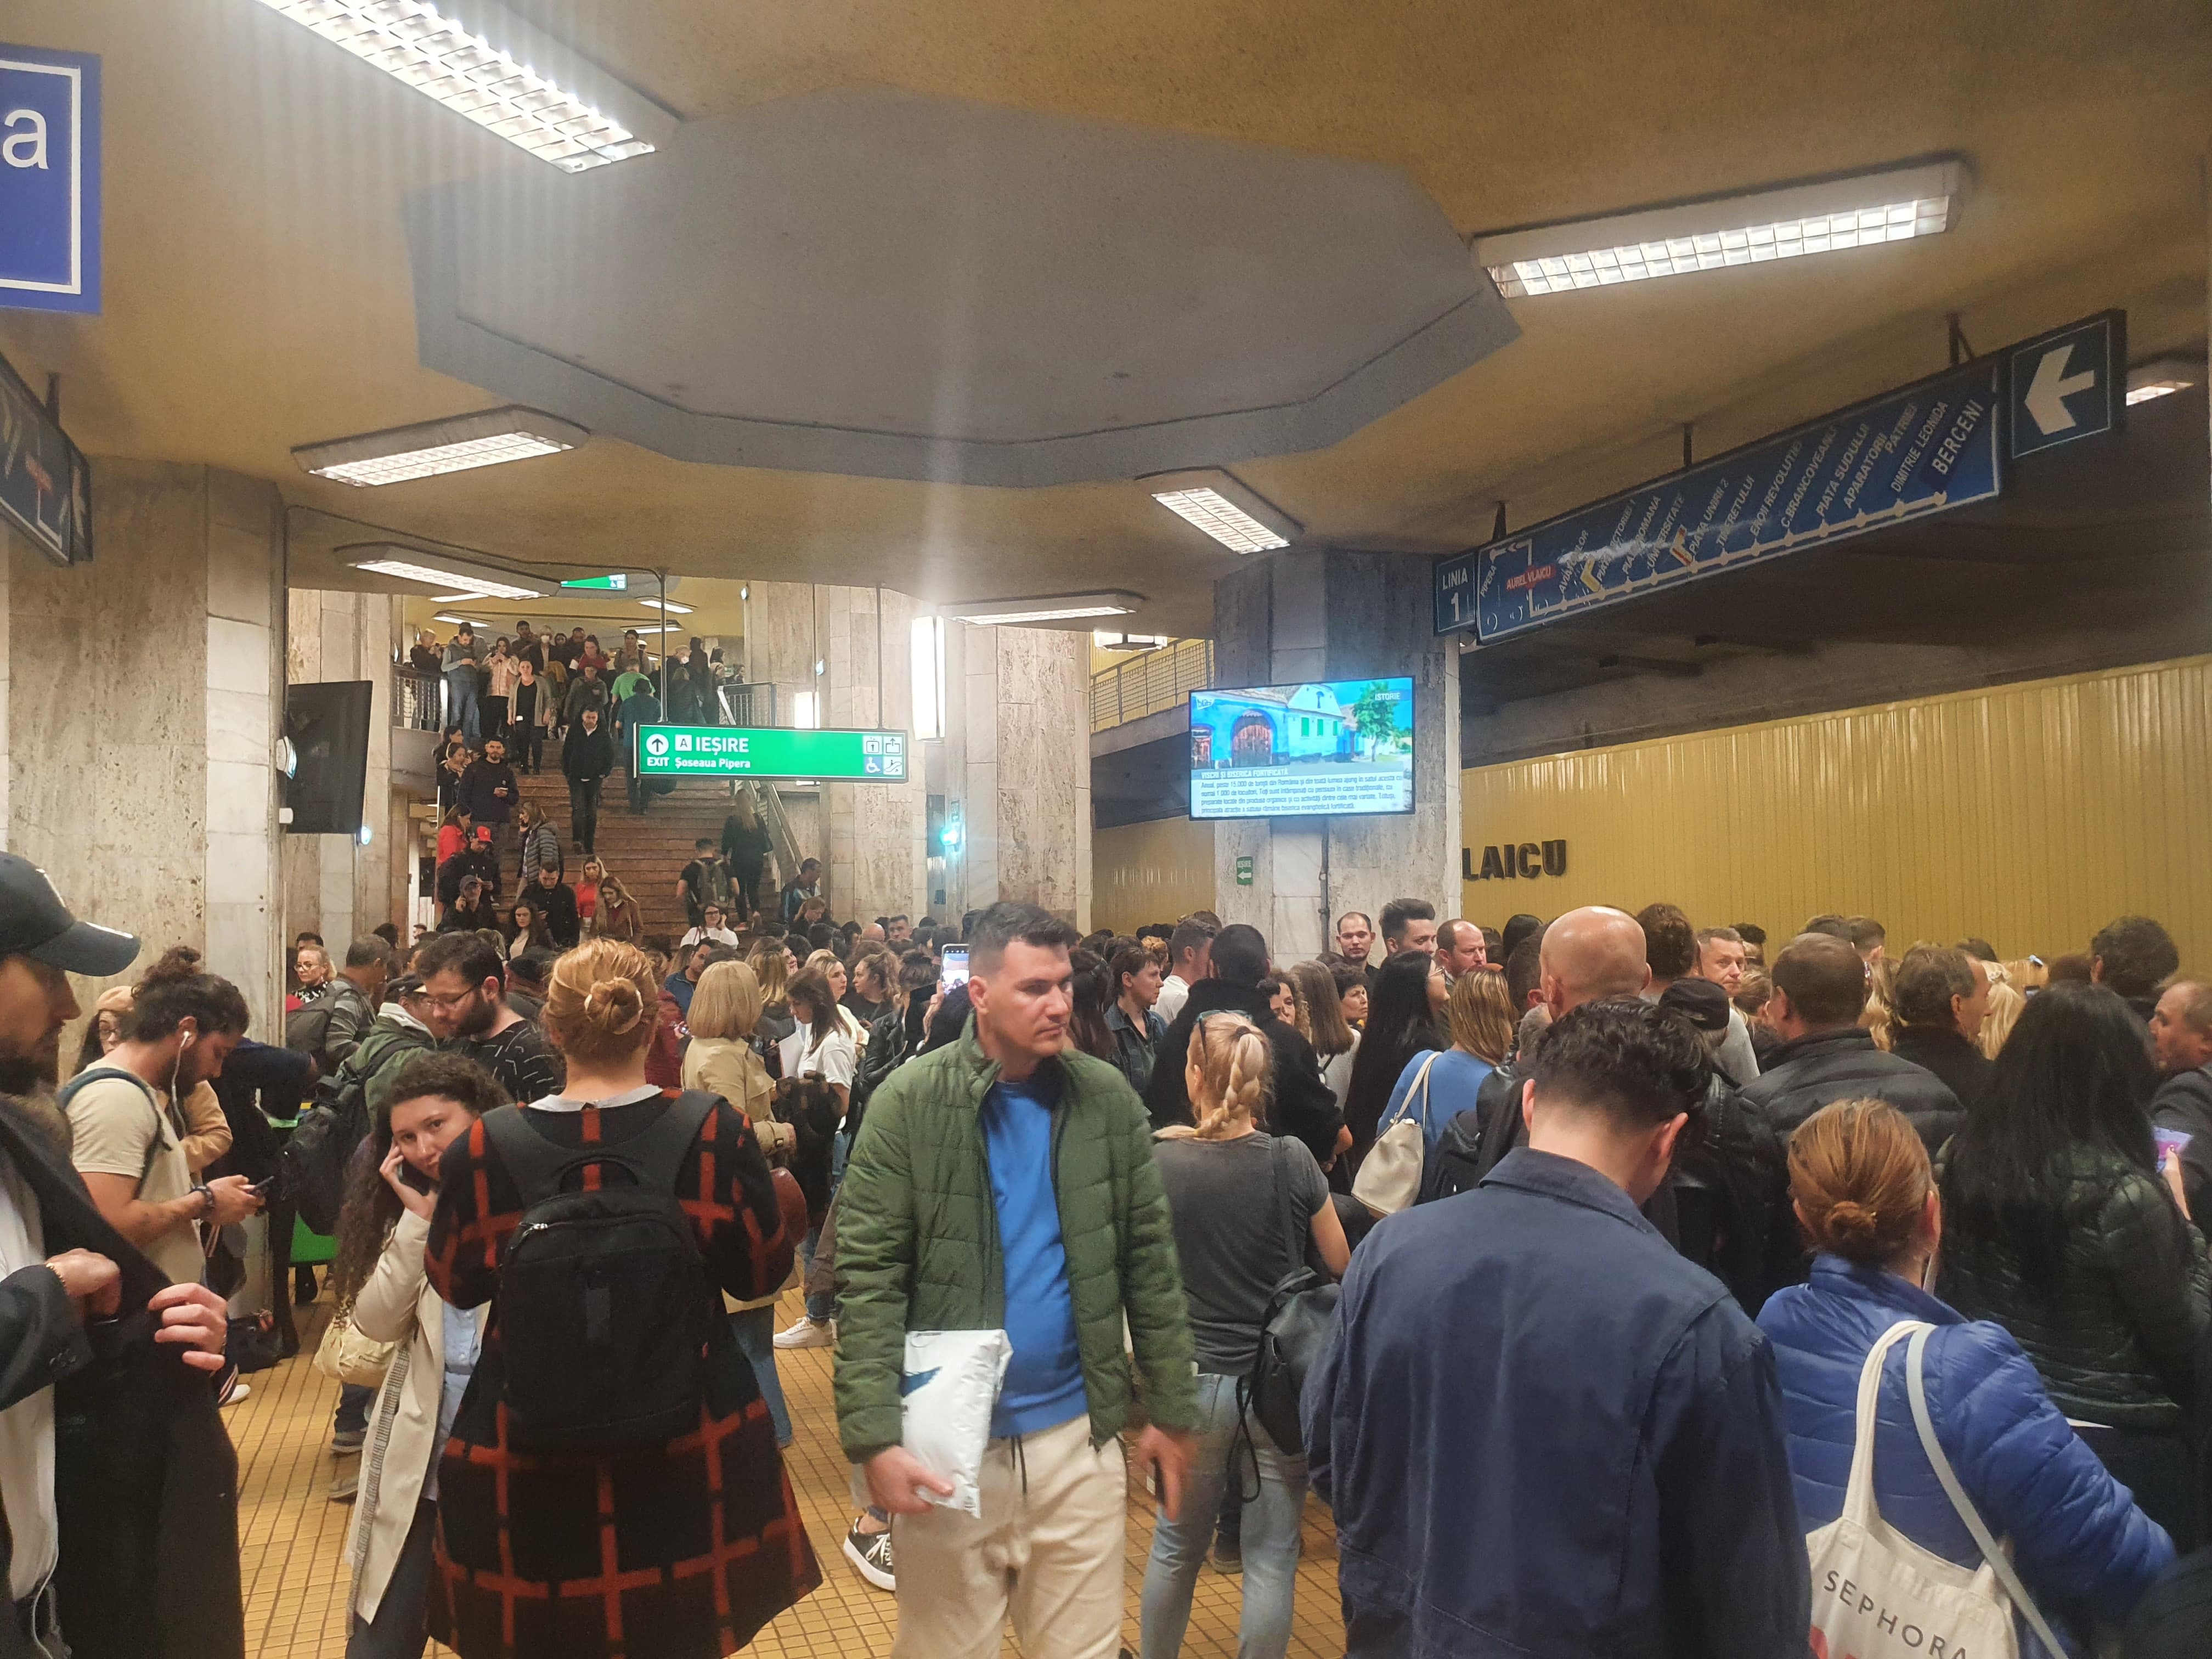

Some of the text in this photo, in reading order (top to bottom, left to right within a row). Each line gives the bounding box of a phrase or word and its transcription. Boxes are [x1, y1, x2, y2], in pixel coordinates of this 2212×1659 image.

[1891, 401, 1948, 493] DIMITRIE LEONIDA
[1932, 399, 1984, 475] BERCENI
[1647, 494, 1685, 568] UNIERSITATE
[1559, 529, 1589, 593] AVIATOLOR
[1442, 567, 1468, 591] LINIA
[1480, 565, 1497, 597] PIPERA
[1506, 566, 1551, 590] AUREL VLAICU
[1451, 592, 1460, 622] 1
[1375, 692, 1401, 701] ISTORIE
[680, 736, 749, 755] A IEȘIRE
[647, 757, 670, 766] EXIT
[719, 758, 751, 770] Pipera
[1462, 839, 1567, 881] LAICU
